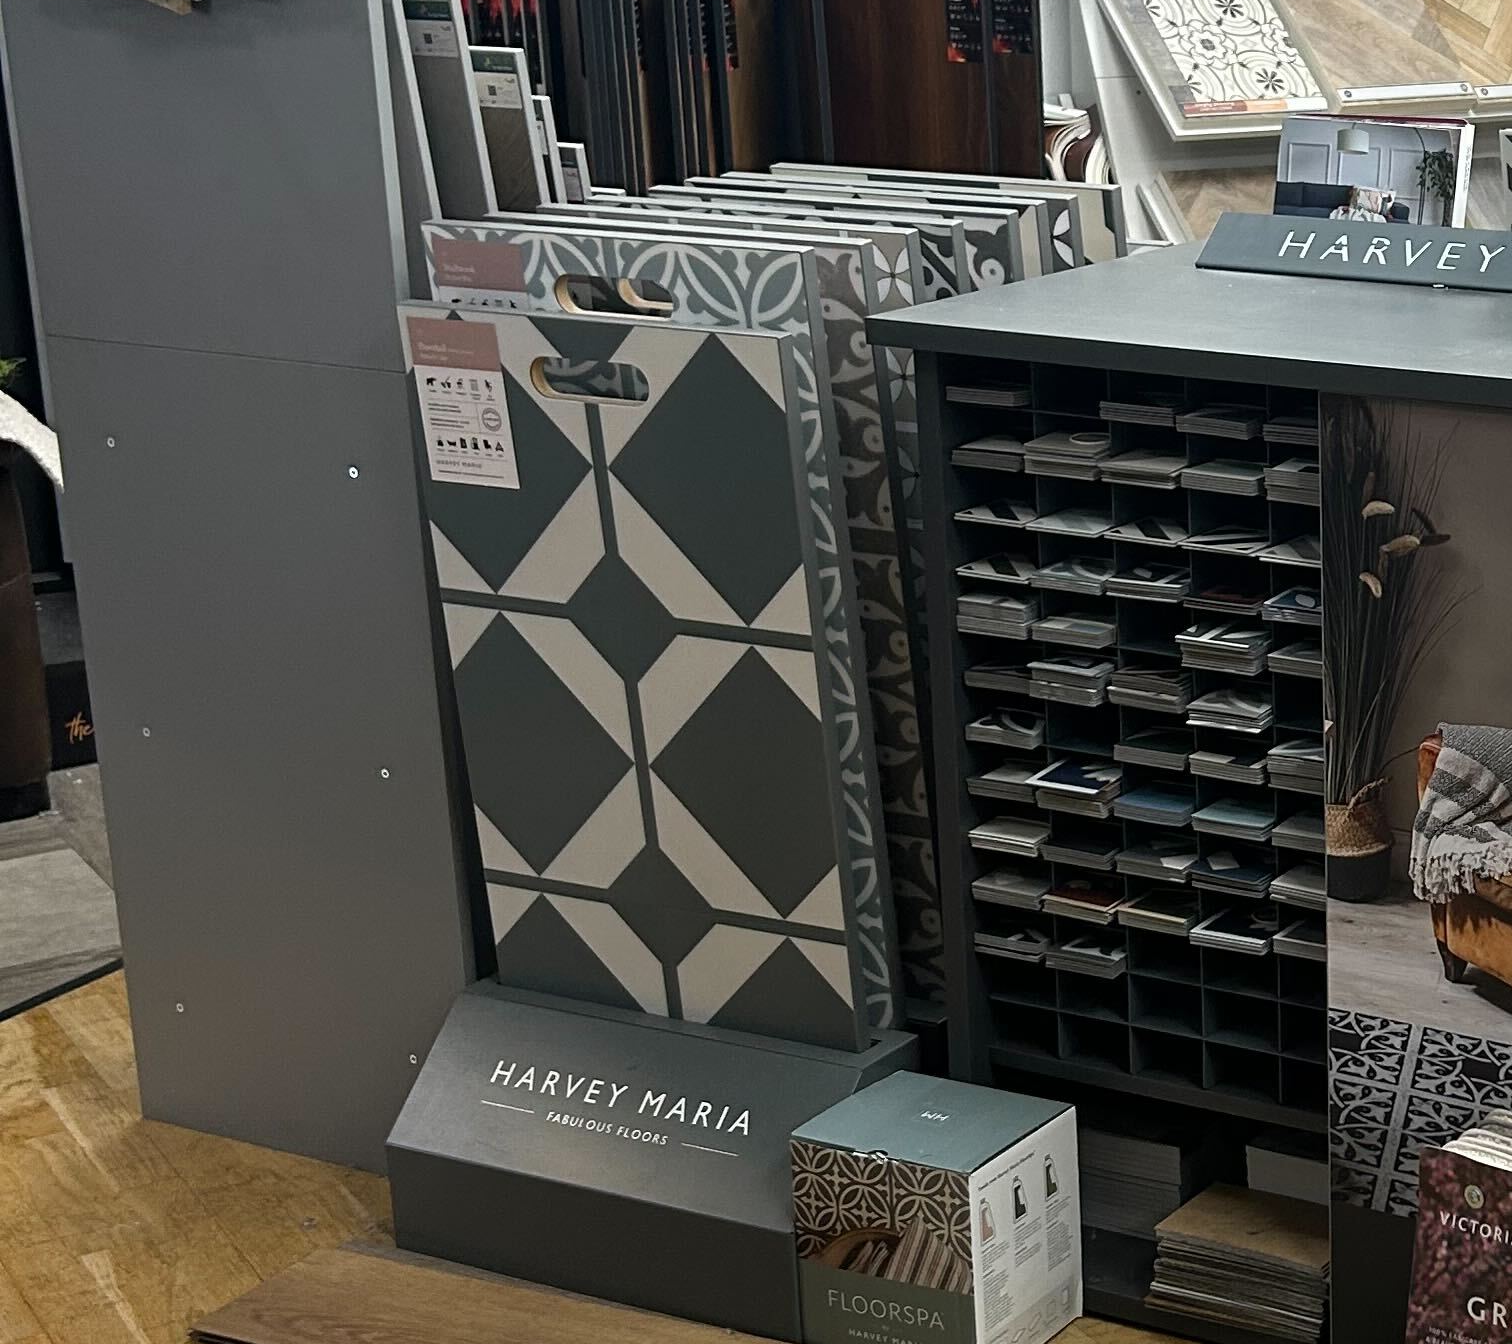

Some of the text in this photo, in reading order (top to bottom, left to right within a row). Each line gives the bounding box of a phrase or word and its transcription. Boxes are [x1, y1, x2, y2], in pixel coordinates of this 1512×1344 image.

[1278, 230, 1507, 274] HARVEY
[490, 1059, 752, 1136] HARVEY MARIA
[545, 1110, 669, 1146] FABULOUS FLOORS
[827, 1288, 945, 1330] FLOORSPA
[848, 1328, 888, 1343] HARVEY
